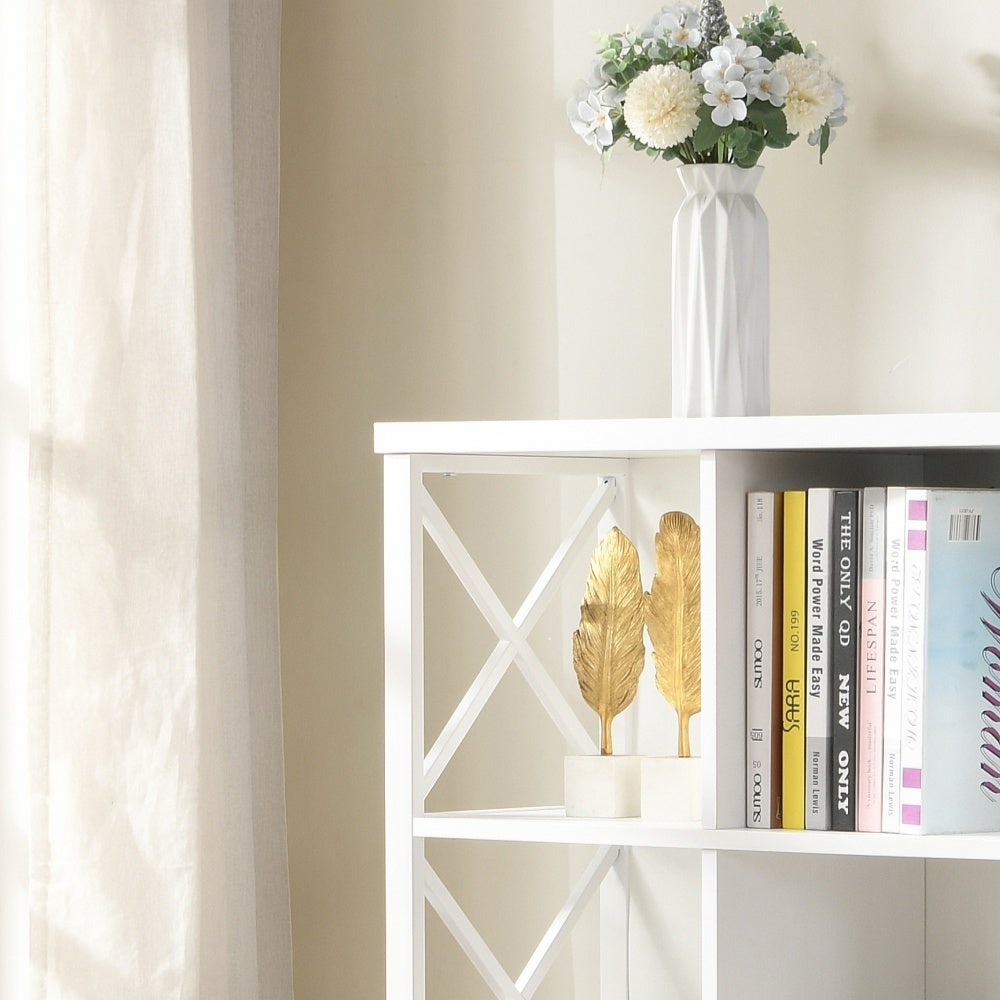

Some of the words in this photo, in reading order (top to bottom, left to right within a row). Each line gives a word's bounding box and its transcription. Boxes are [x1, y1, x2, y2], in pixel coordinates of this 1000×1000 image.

[840, 511, 852, 552] THE
[812, 538, 824, 573] Word
[812, 578, 824, 620] Power
[840, 556, 853, 611] ONLY
[890, 579, 901, 620] Power
[790, 610, 800, 652] NO.199
[811, 625, 823, 663] Made
[838, 619, 851, 647] QD
[866, 600, 878, 695] LIFESPAN
[889, 626, 900, 663] Made
[809, 667, 822, 699] Easy
[838, 673, 851, 730] NEW
[887, 668, 899, 700] Easy
[782, 679, 801, 733] SARA
[812, 751, 821, 786] Norman
[837, 750, 850, 815] ONLY
[811, 789, 821, 815] Lewis
